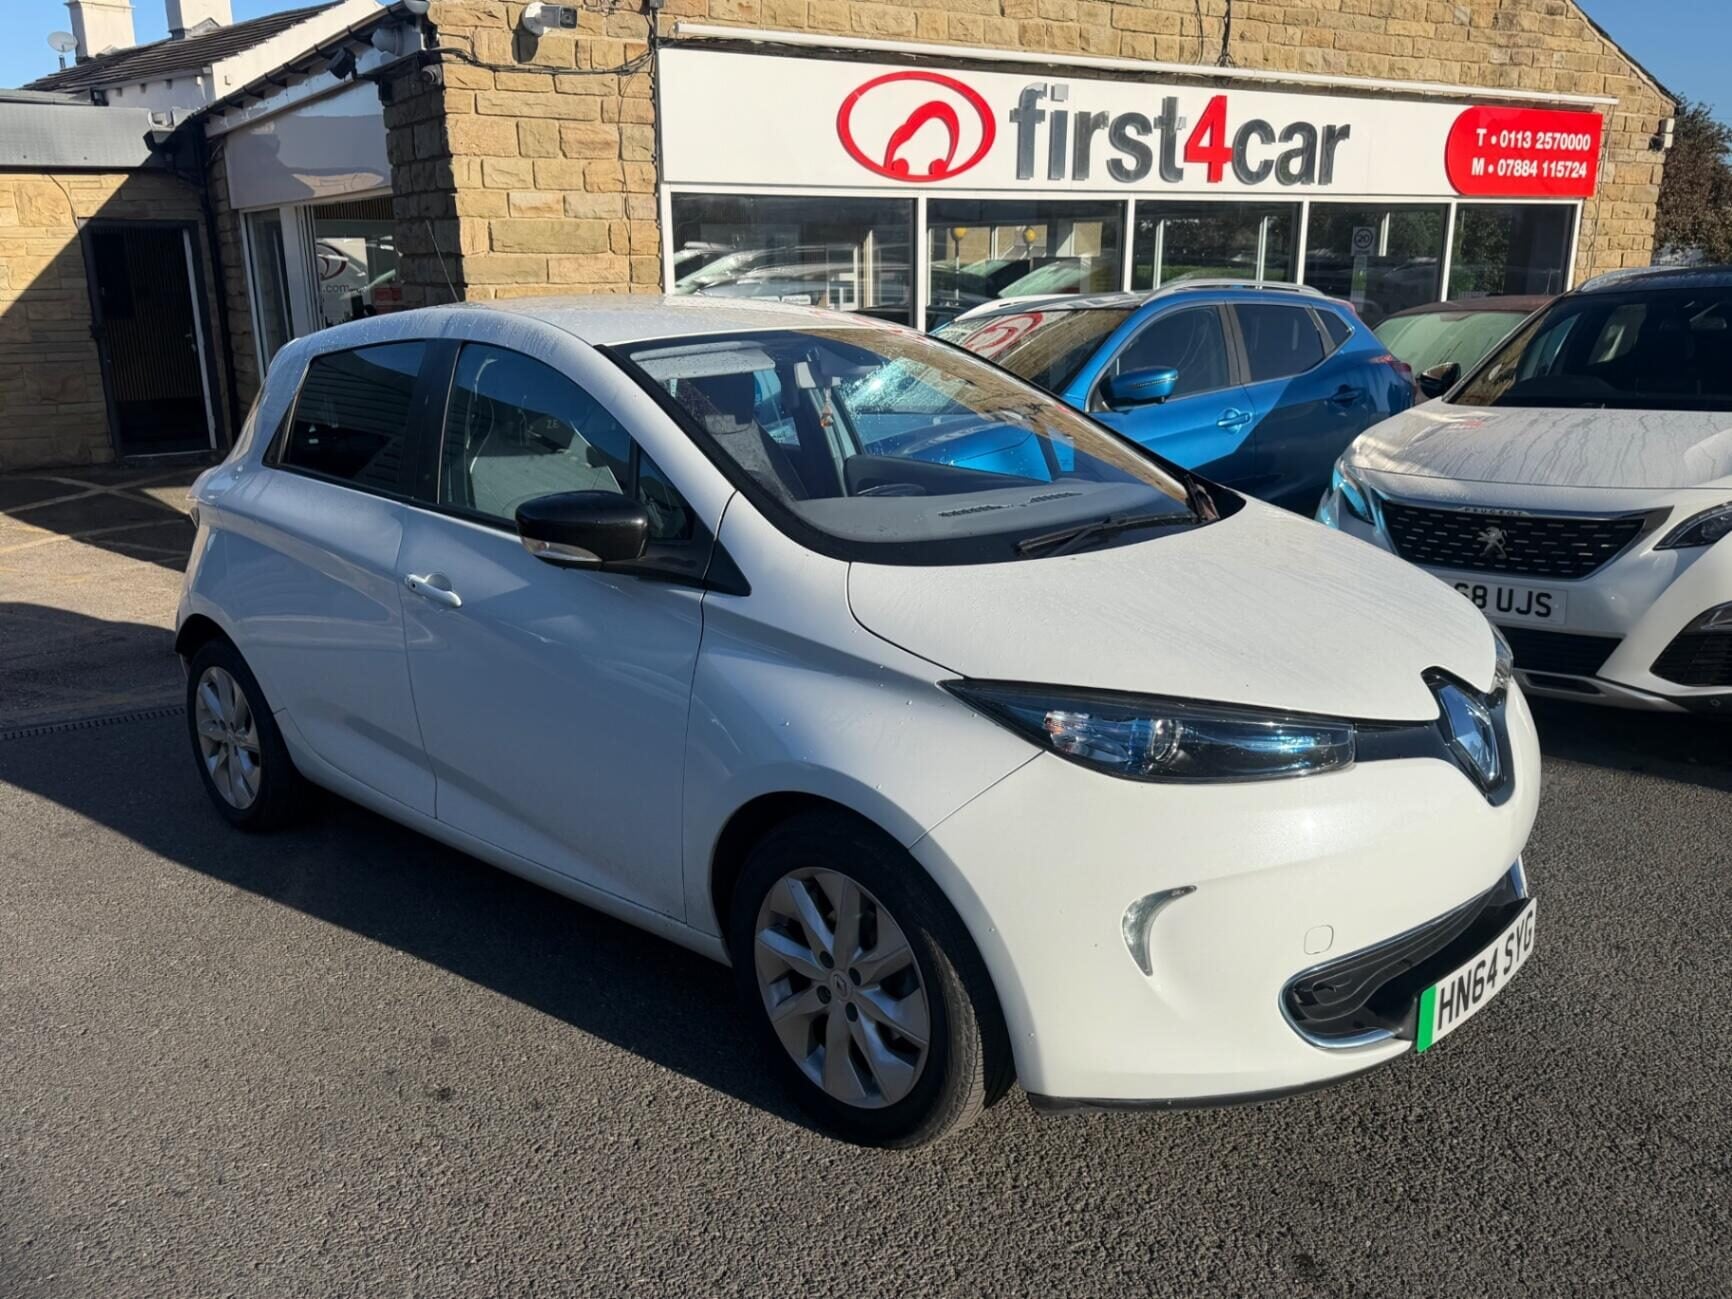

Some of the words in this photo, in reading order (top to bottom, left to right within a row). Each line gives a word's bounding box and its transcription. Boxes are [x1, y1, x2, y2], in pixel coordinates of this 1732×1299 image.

[1009, 82, 1351, 186] first4car
[1476, 128, 1487, 147] T
[1499, 130, 1532, 148] 0113
[1536, 131, 1592, 151] 2570000
[1471, 157, 1485, 175] M
[1497, 158, 1538, 177] 07884
[1542, 160, 1587, 178] 115724
[1496, 587, 1552, 618] UJS
[1438, 947, 1498, 1031] HN64
[1503, 910, 1533, 975] SYG
